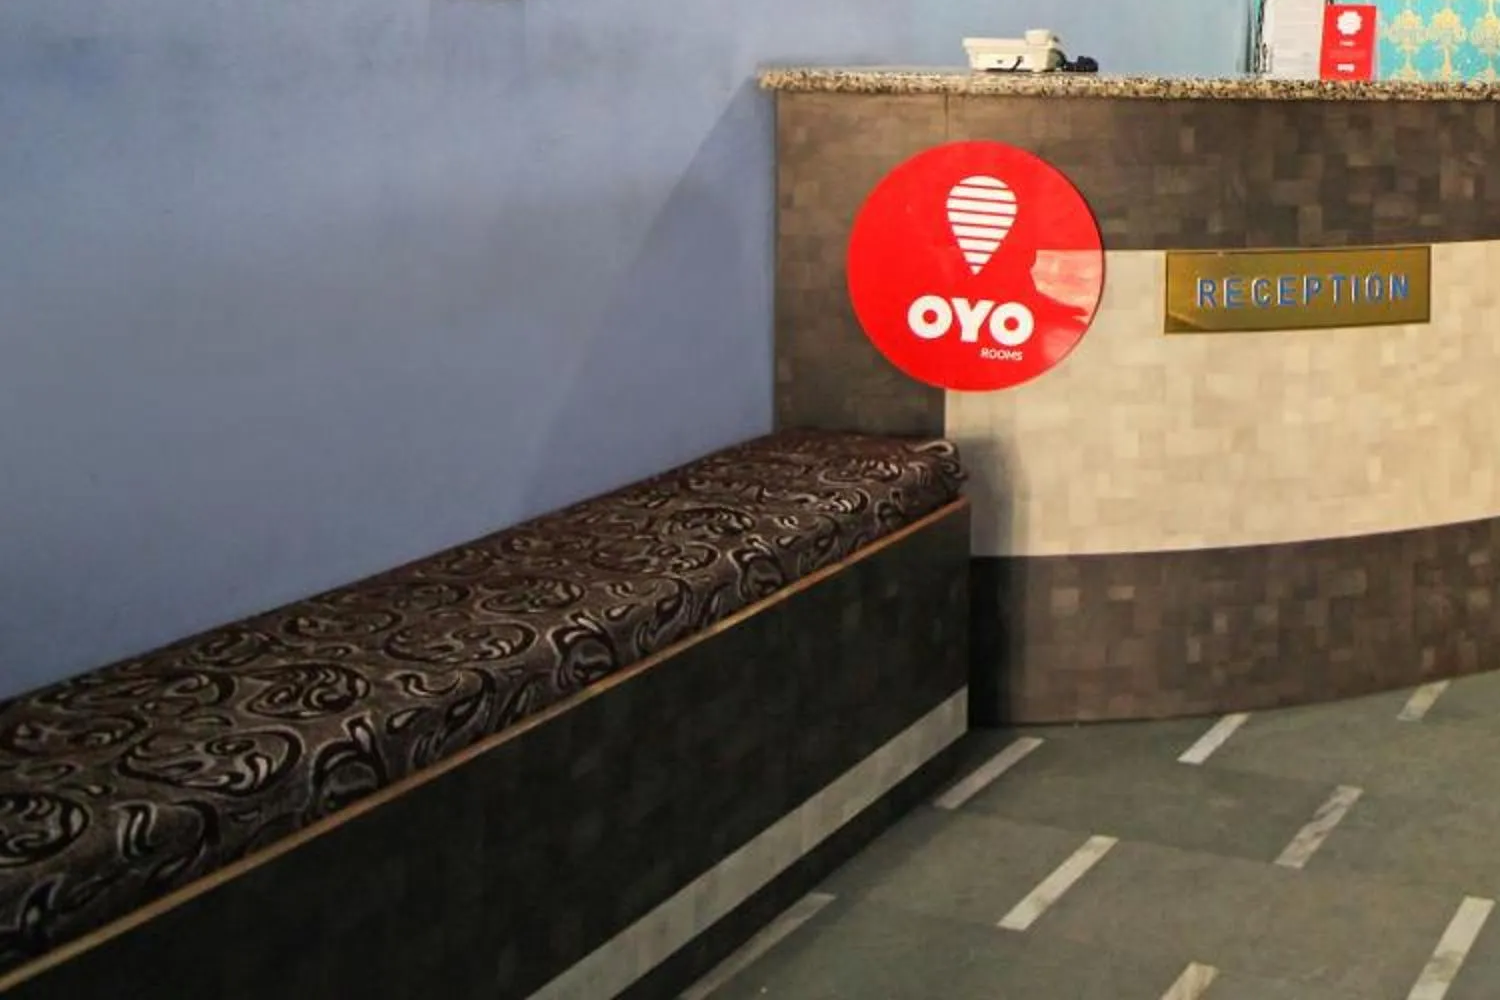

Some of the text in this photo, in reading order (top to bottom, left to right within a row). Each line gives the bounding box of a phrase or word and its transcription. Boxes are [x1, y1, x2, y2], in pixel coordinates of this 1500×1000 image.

[1196, 272, 1410, 308] RECEPTION
[907, 295, 1034, 346] OYO
[980, 347, 1023, 361] ROOMS
